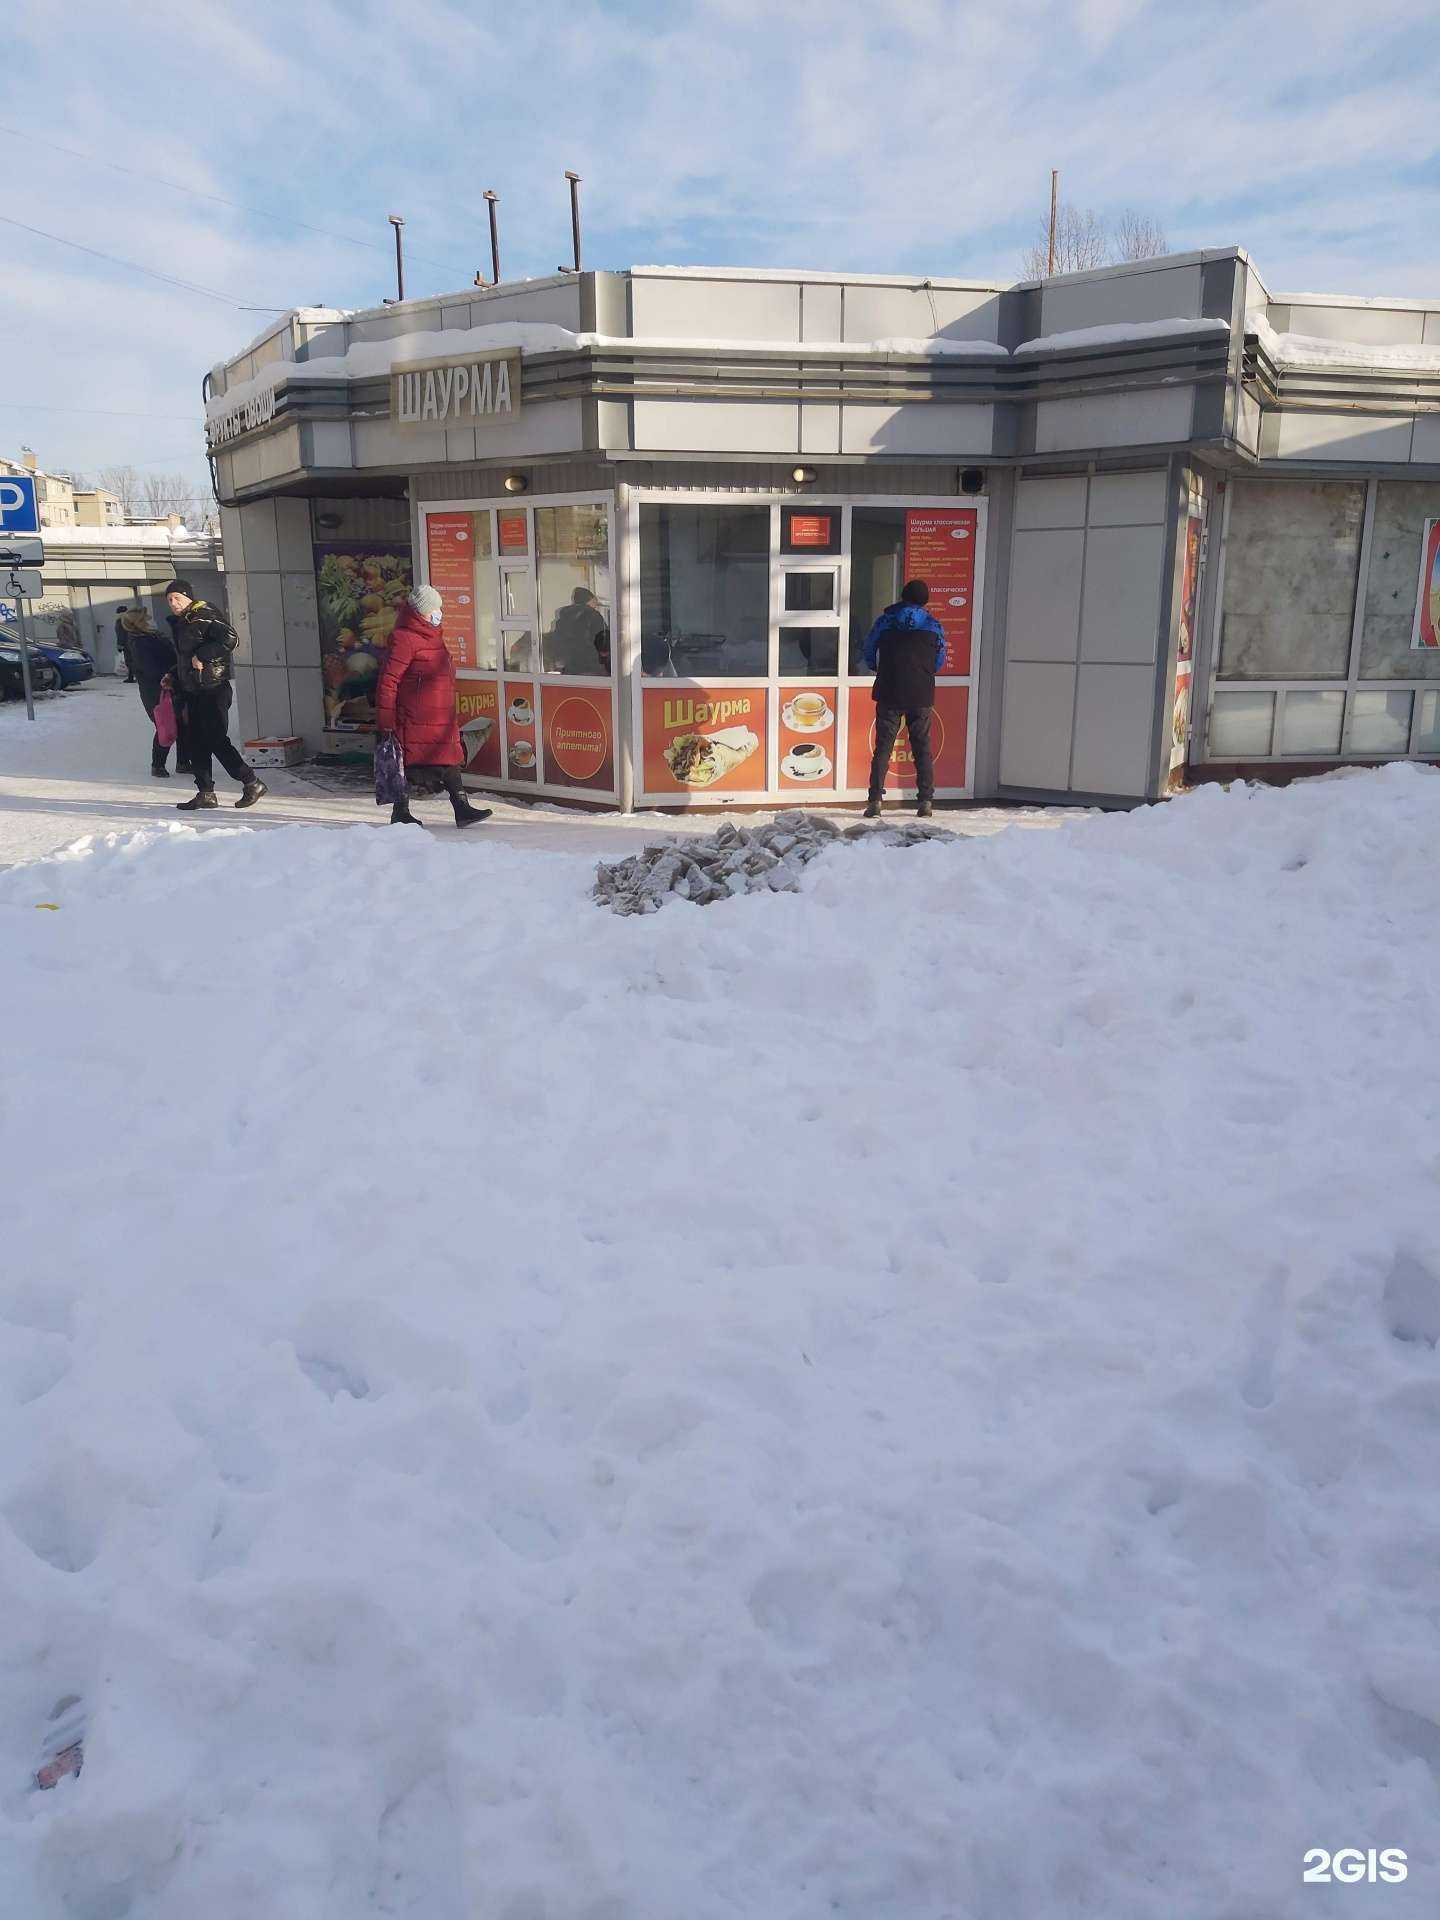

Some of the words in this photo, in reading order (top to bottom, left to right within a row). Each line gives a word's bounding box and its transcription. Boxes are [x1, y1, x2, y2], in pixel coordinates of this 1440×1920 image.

[397, 360, 512, 424] ШАУРМА
[455, 691, 495, 718] аурма
[663, 696, 751, 730] Шаурма
